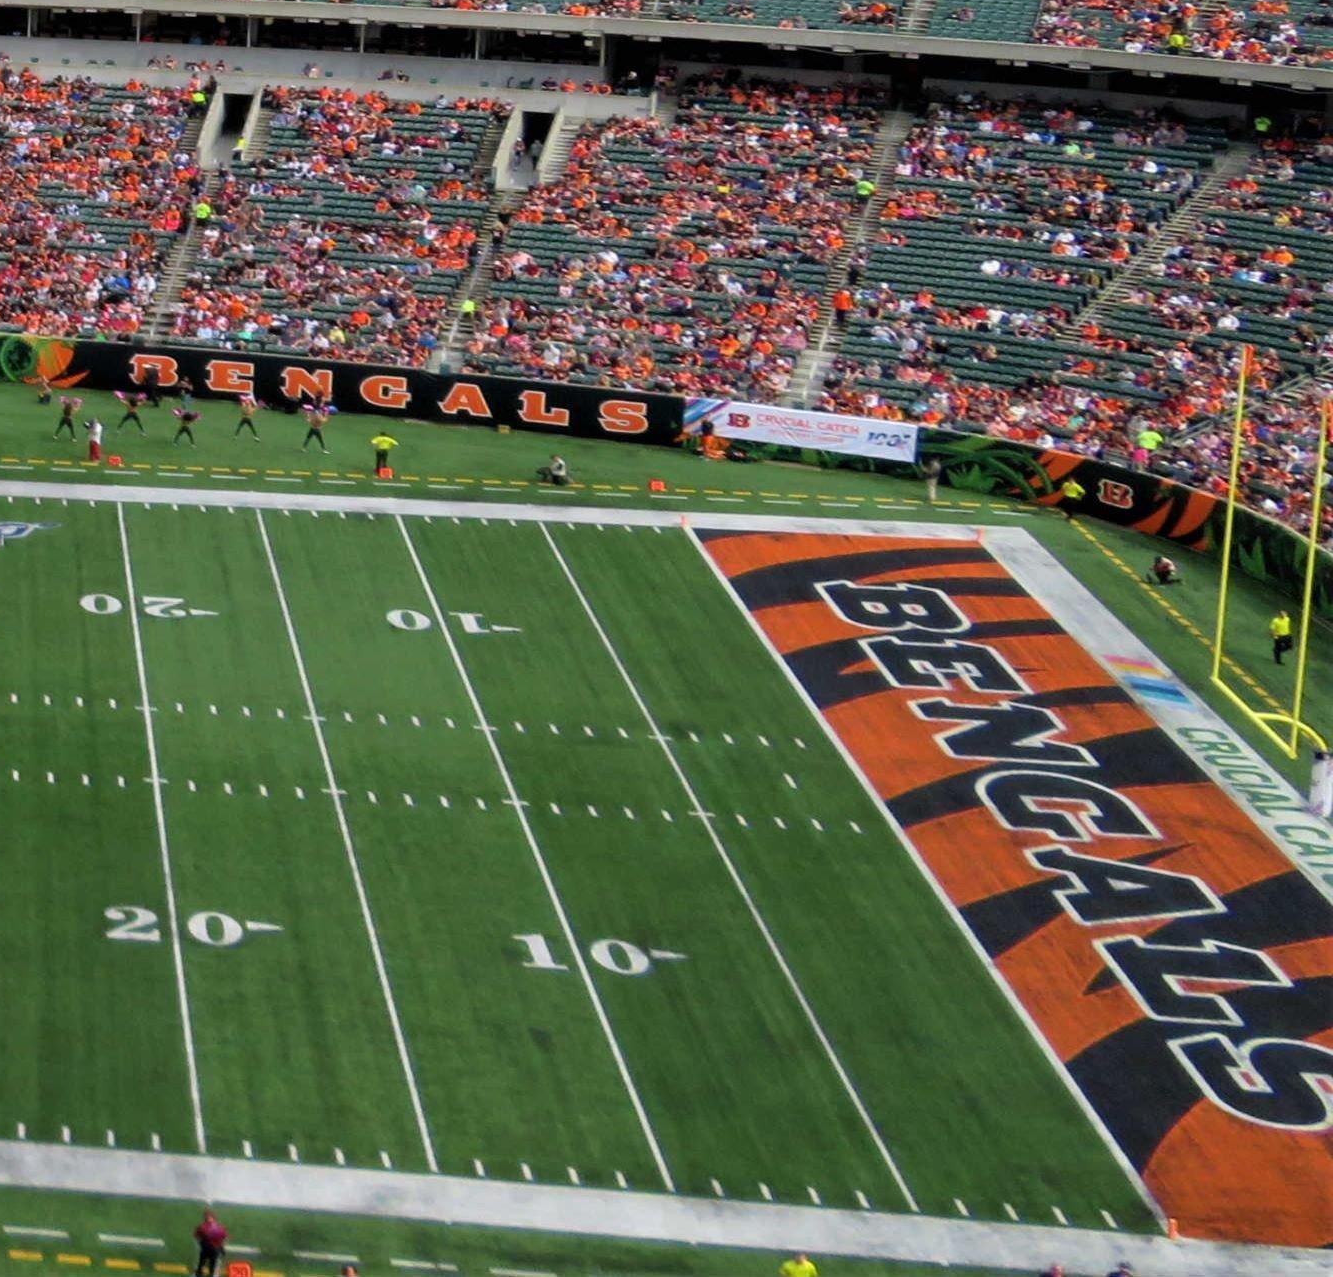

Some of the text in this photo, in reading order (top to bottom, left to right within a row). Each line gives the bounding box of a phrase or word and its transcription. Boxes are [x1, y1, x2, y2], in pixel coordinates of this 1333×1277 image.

[128, 353, 650, 435] BENGALS
[756, 413, 811, 429] CRUCIAL
[79, 594, 189, 619] 20
[386, 608, 495, 635] 10
[1176, 725, 1307, 819] CRUCIAL
[814, 579, 1333, 1132] BENGALS
[104, 905, 247, 947] 20
[510, 930, 653, 976] 10
